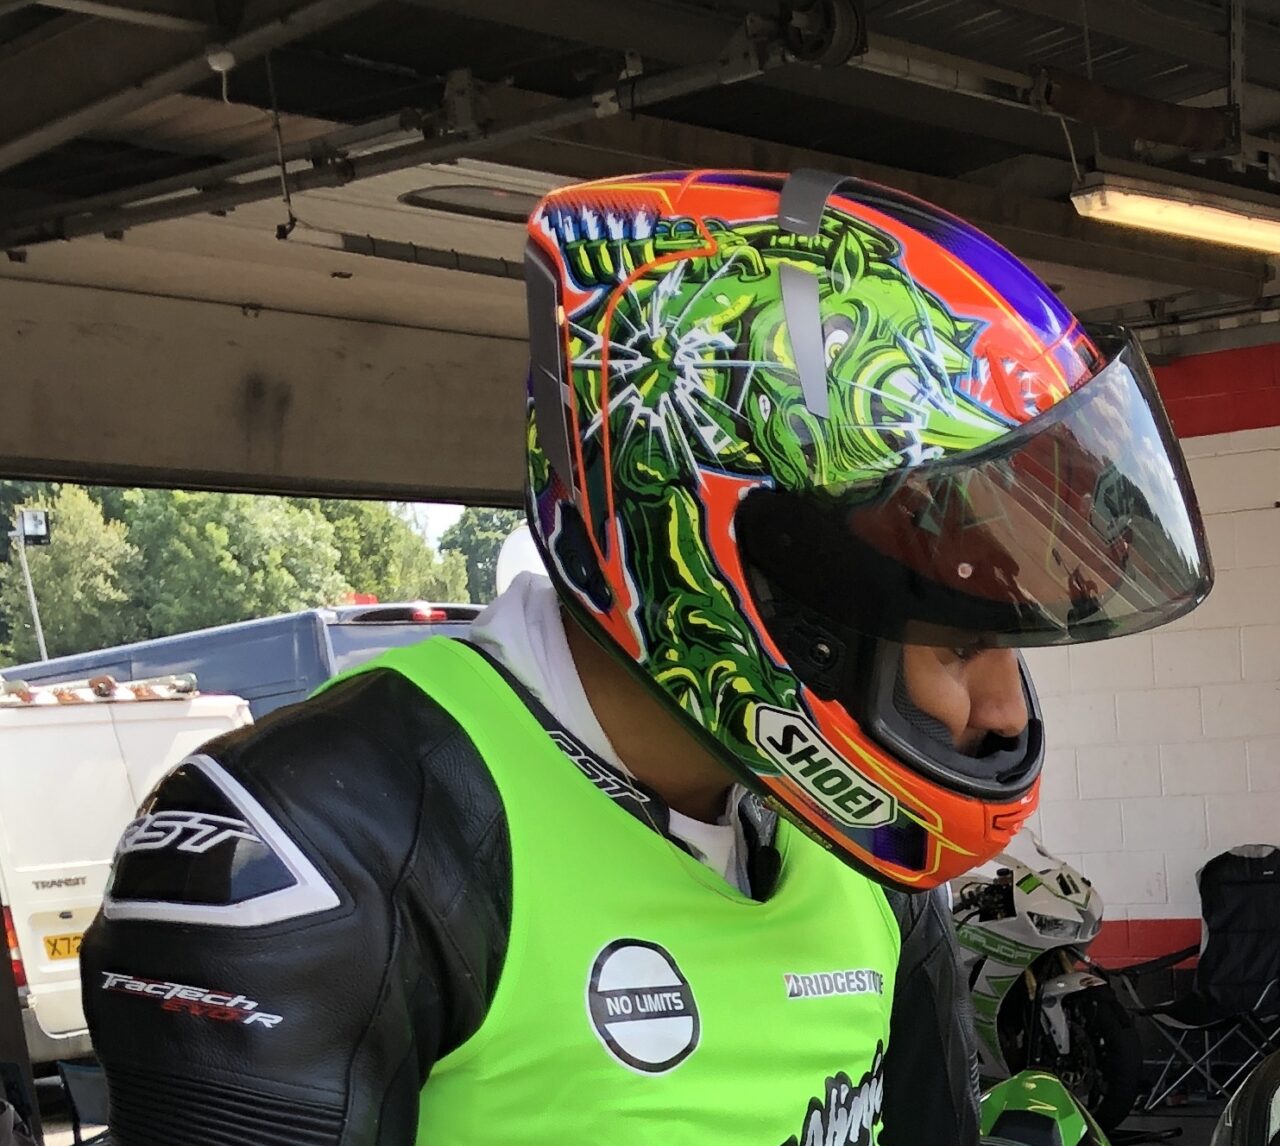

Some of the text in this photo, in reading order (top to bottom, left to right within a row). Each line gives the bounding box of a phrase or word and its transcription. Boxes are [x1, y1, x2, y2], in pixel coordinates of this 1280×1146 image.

[766, 723, 885, 821] SHOEI
[32, 876, 87, 890] TRANSIT
[605, 991, 685, 1017] NO LIMITS
